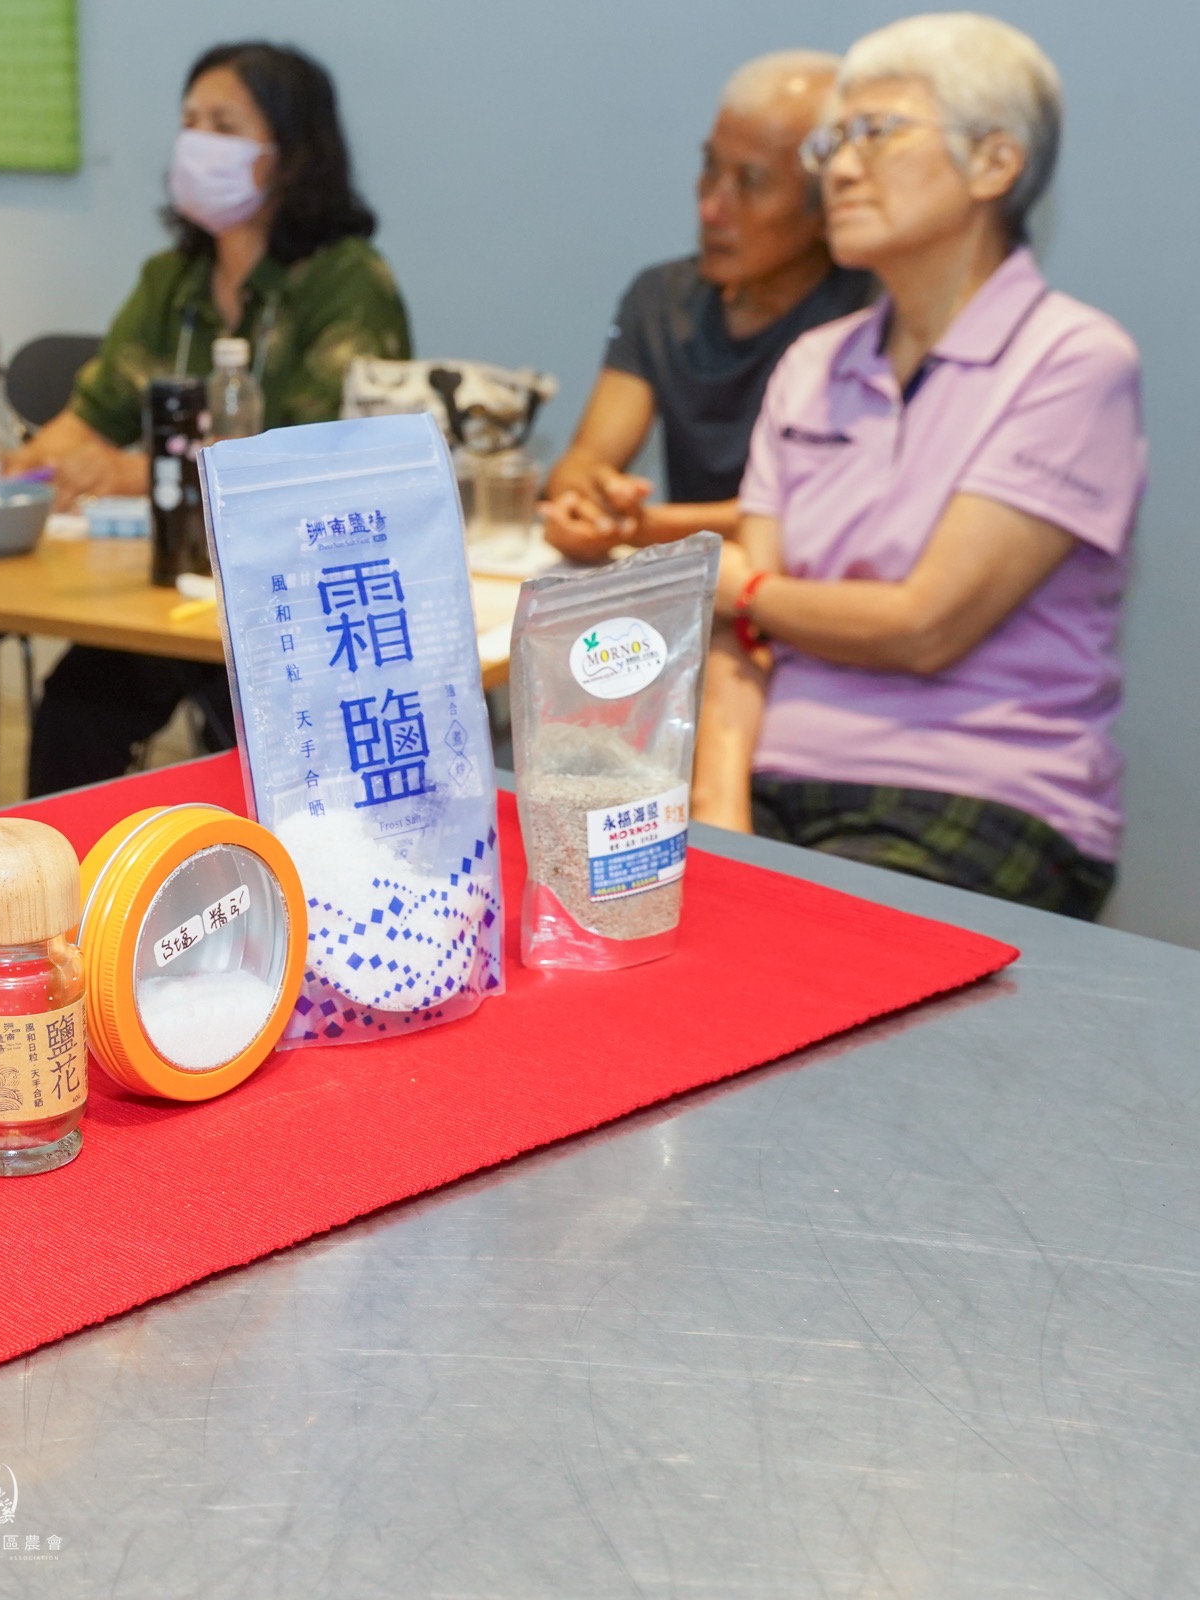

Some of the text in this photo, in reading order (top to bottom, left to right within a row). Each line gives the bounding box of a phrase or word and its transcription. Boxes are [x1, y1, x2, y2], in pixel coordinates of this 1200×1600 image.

[271, 574, 303, 683] 風和日粒
[586, 640, 651, 667] MORNOS
[317, 557, 437, 809] 霜鹽
[609, 821, 658, 841] MORNOS
[46, 1012, 80, 1100] 鹽花
